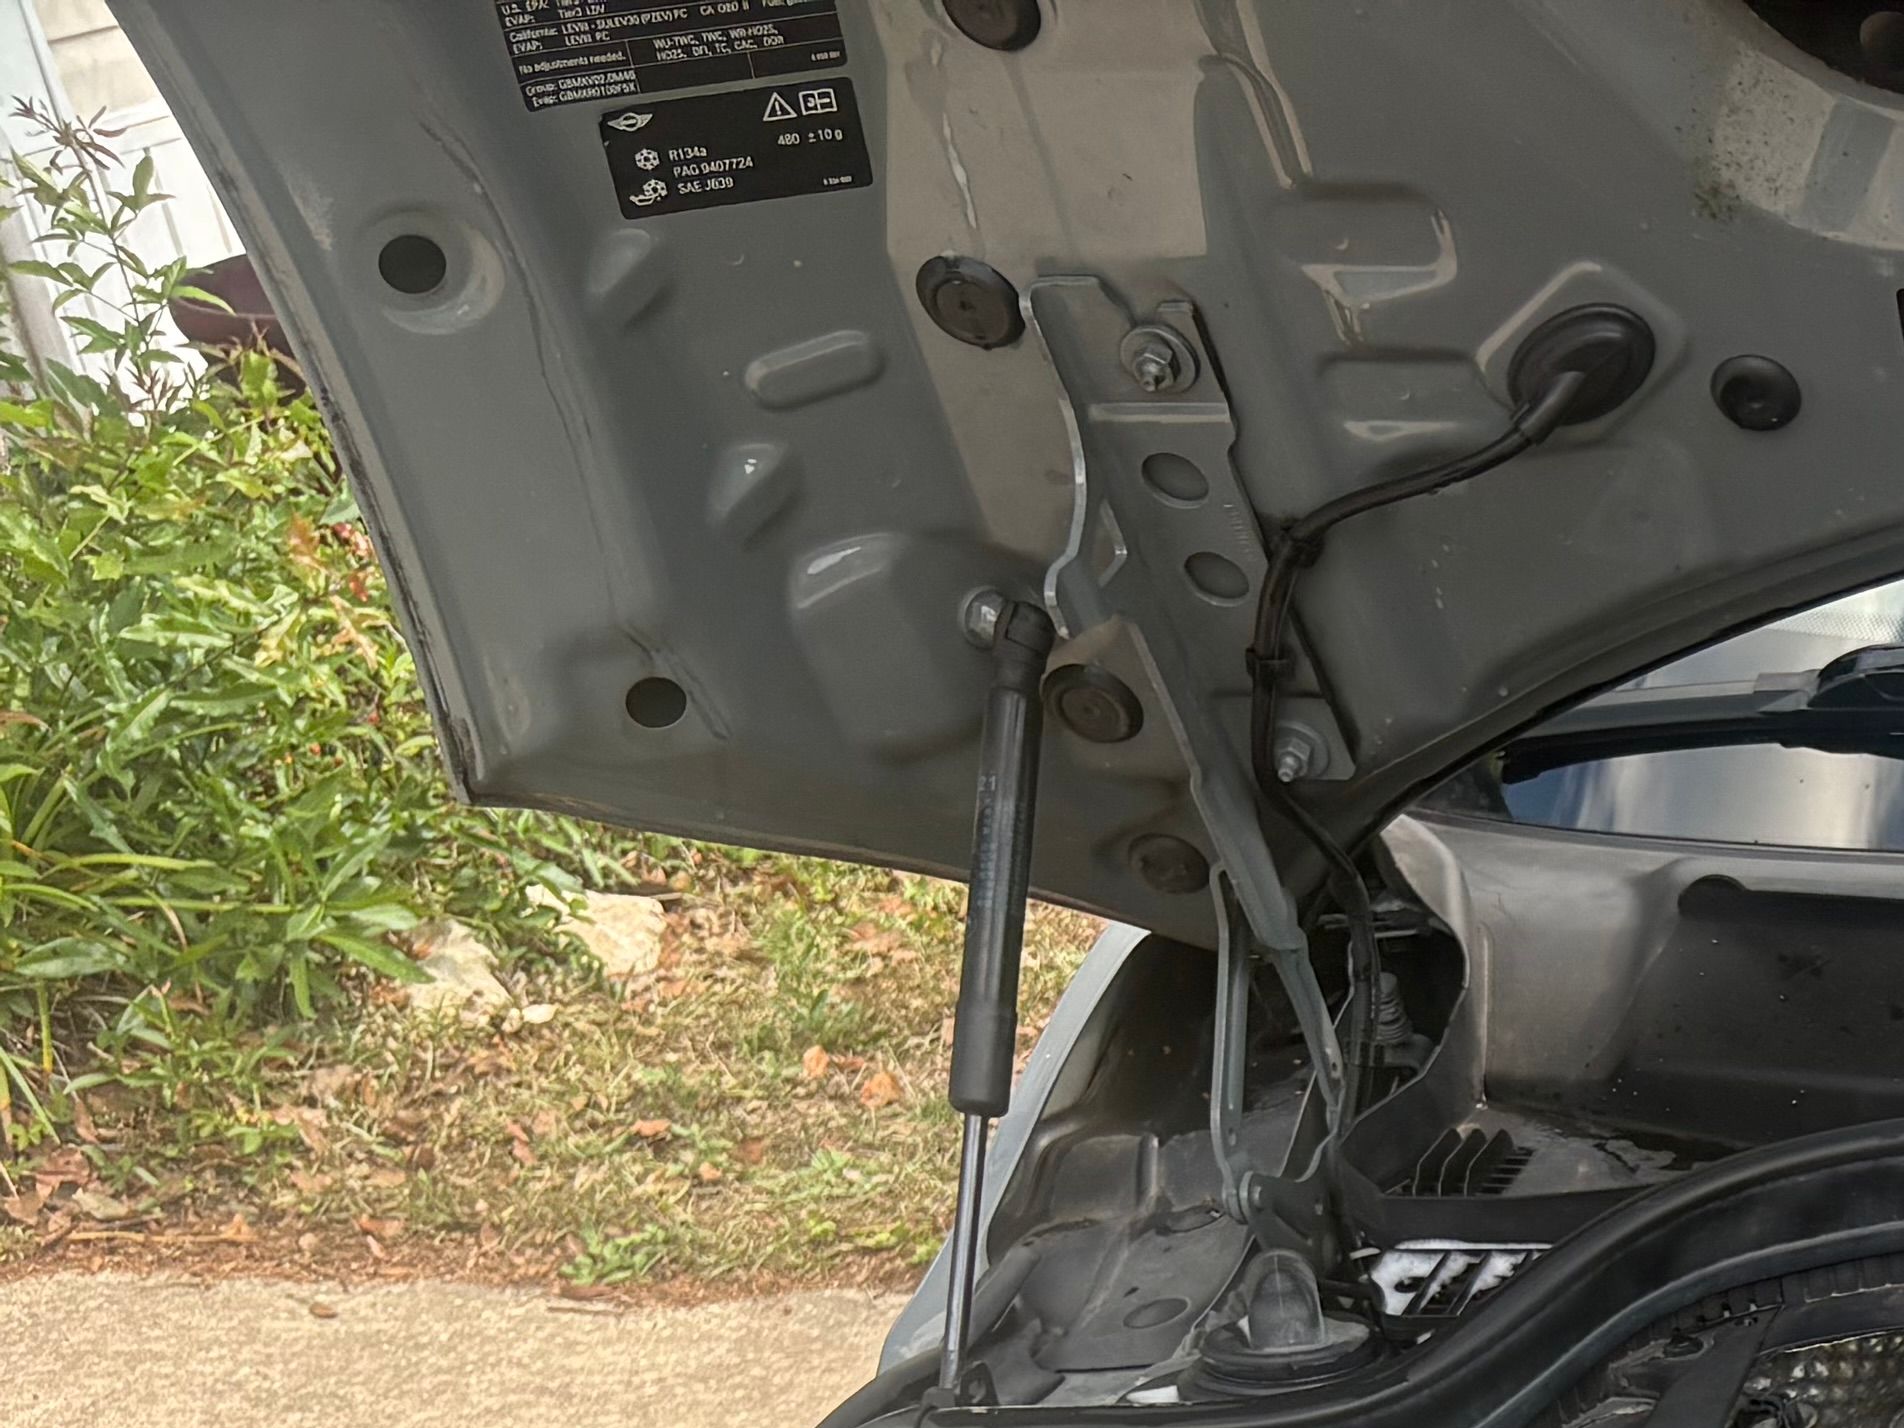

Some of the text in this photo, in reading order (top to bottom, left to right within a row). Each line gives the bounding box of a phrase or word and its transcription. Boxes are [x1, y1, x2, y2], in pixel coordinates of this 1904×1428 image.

[519, 64, 533, 75] No
[534, 56, 590, 73] adjustments
[777, 133, 801, 147] 480
[834, 129, 844, 142] g
[668, 146, 708, 163] R134a
[676, 179, 703, 195] SAE
